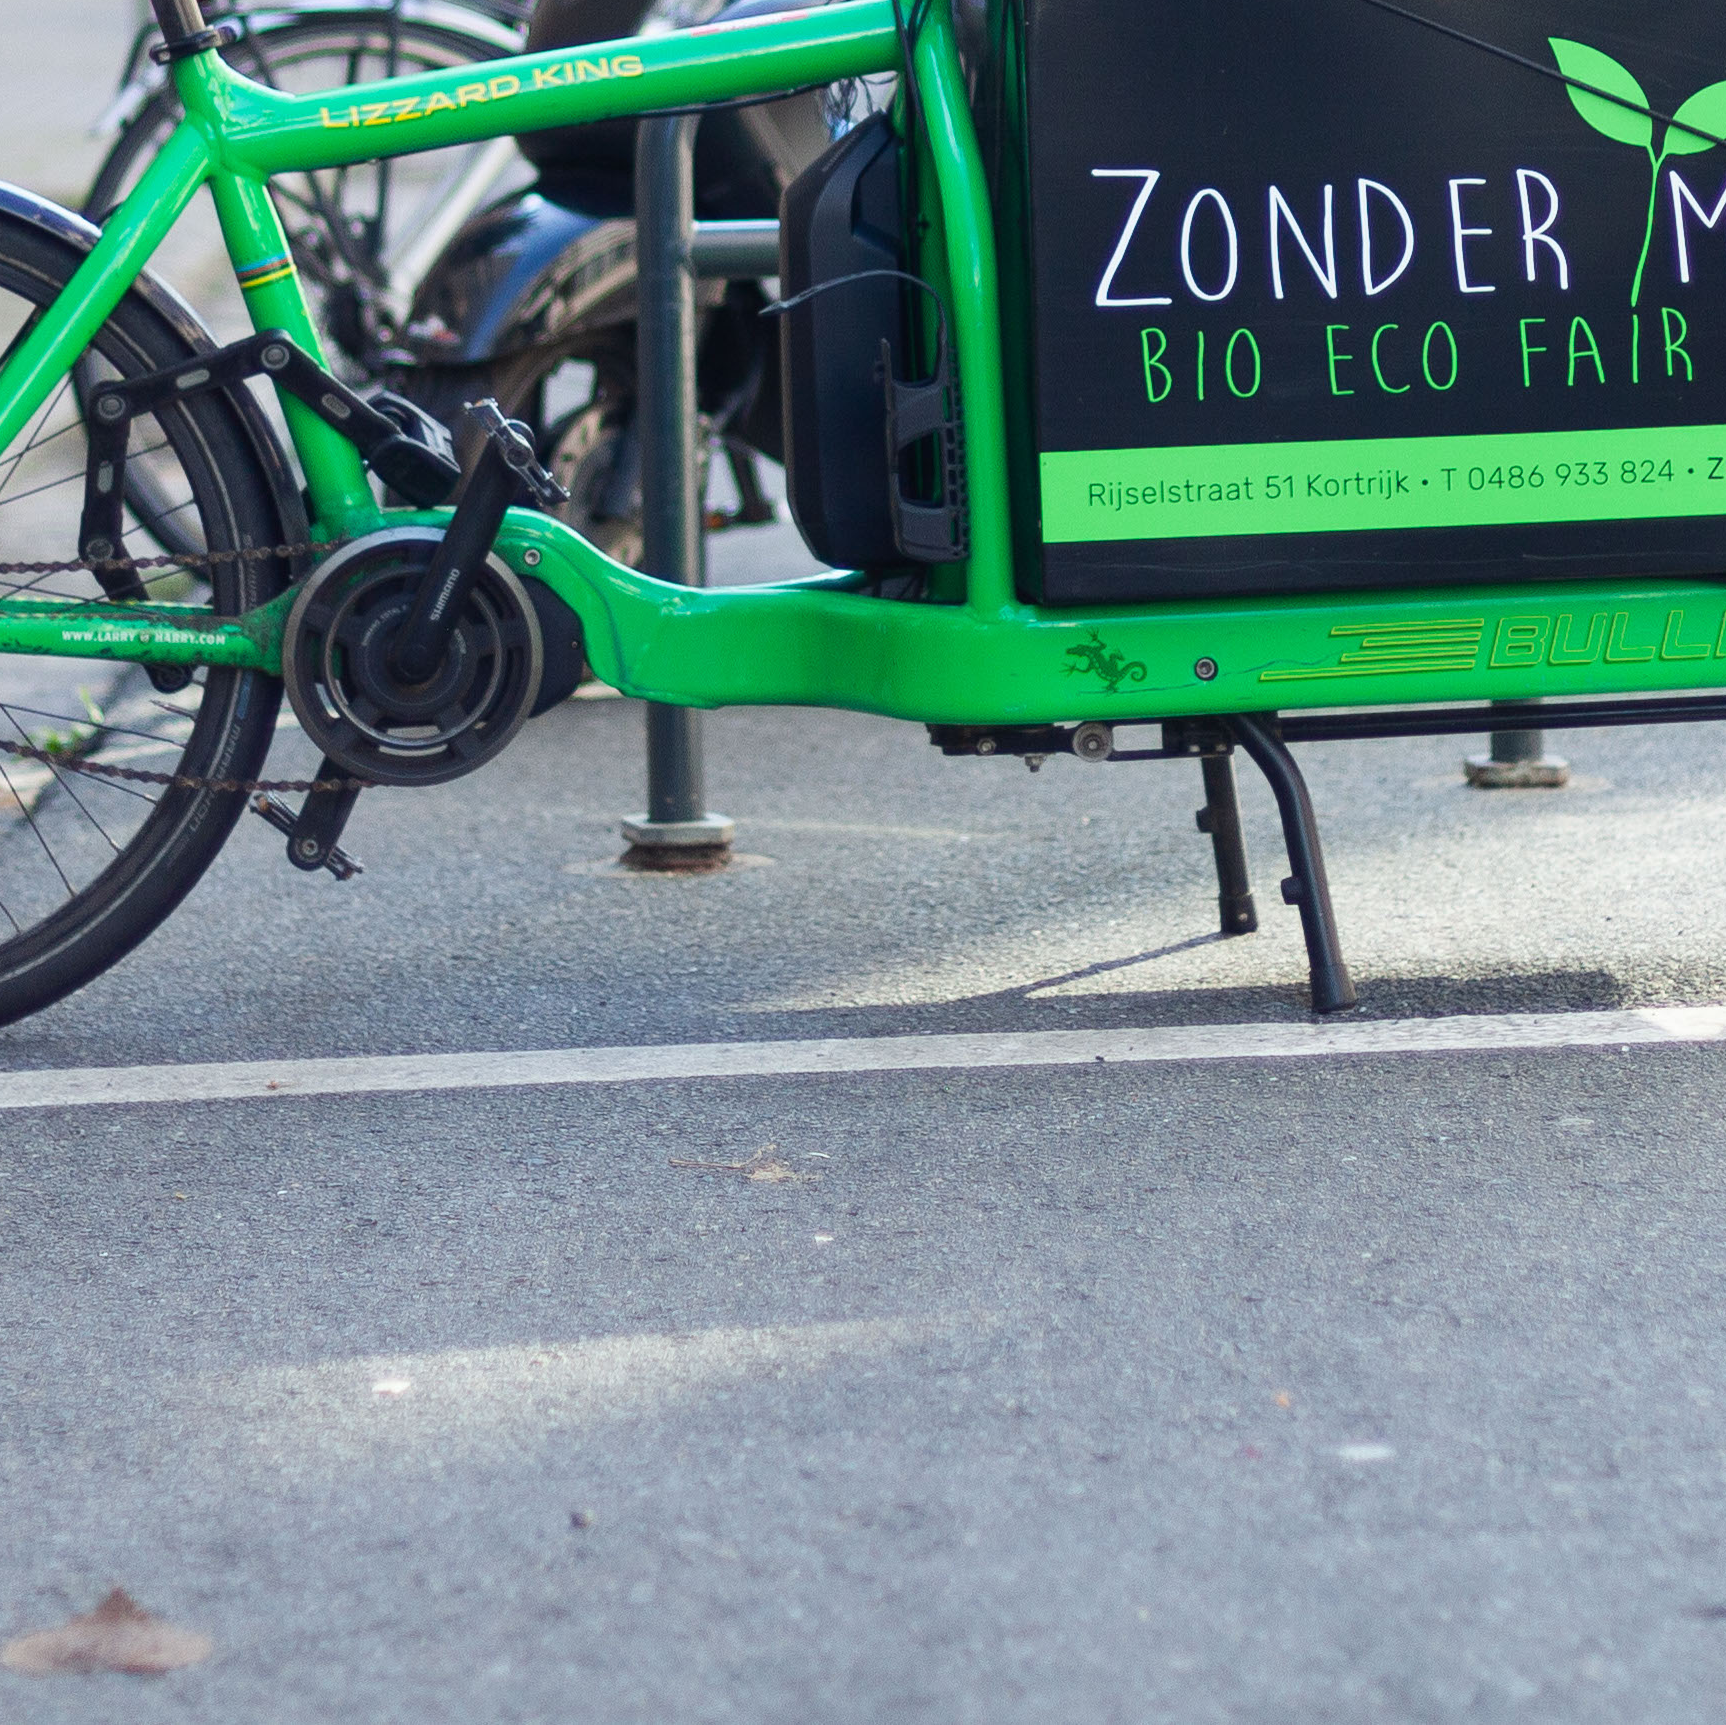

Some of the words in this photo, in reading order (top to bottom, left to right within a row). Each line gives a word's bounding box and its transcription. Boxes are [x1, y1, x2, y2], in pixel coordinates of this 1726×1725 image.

[320, 75, 521, 129] LIZZARD
[531, 55, 646, 90] KING
[1091, 167, 1569, 308] ZONDER
[1139, 326, 1262, 404] BIO
[1326, 320, 1459, 397] ECO
[1518, 306, 1693, 389] FAIR
[1088, 477, 1254, 512] Rijselstraat
[1265, 475, 1295, 499] 51
[1306, 469, 1411, 499] Kortrijk
[1440, 467, 1458, 491] T
[1468, 464, 1545, 491] 0486
[1555, 462, 1608, 487] 933
[1620, 459, 1675, 485] 824
[429, 568, 460, 622] SHIMANO
[61, 630, 135, 643] WWW.LARRY
[154, 631, 226, 645] HARRY.COM
